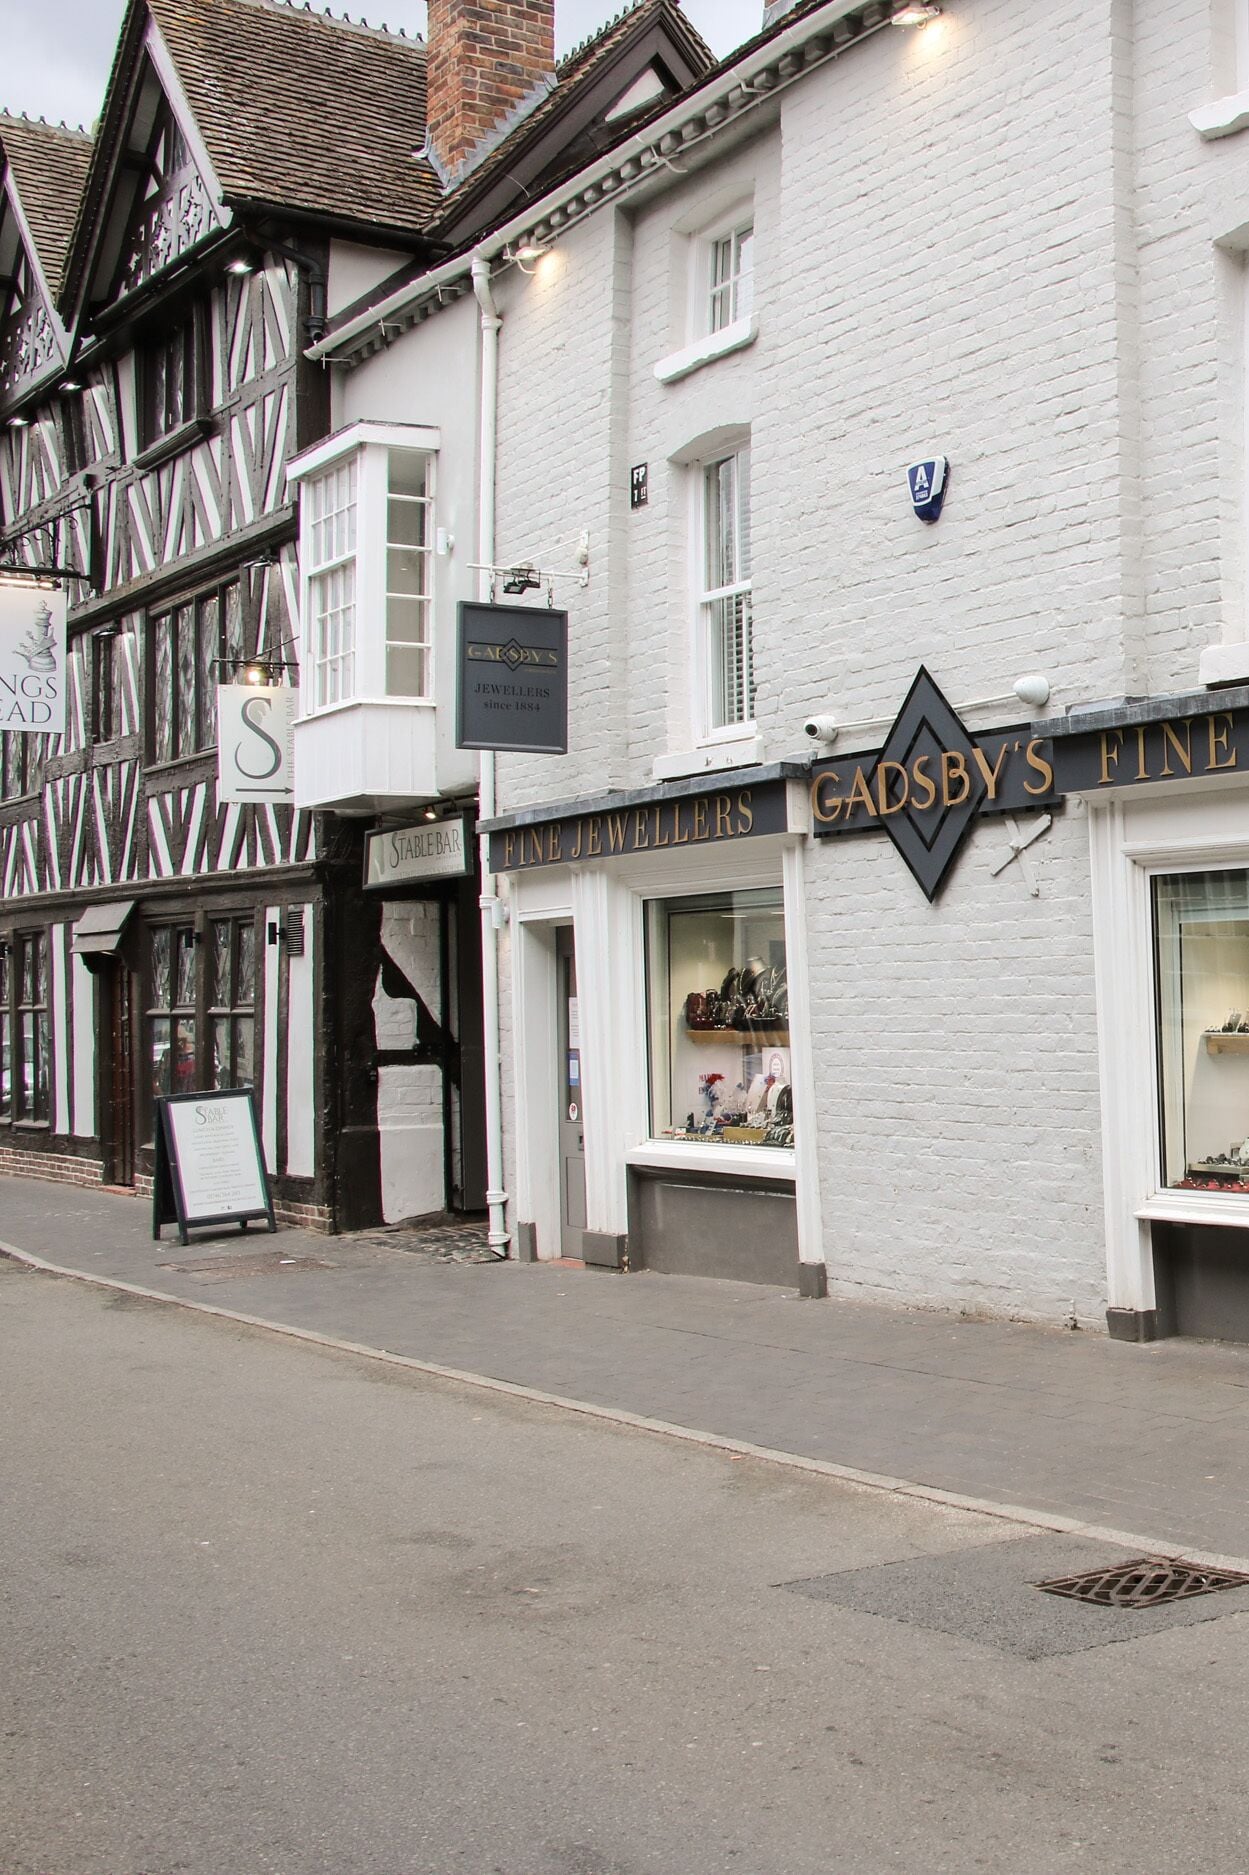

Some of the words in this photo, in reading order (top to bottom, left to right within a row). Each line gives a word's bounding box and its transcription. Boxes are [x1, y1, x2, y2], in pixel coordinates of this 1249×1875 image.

[633, 466, 646, 484] FP
[914, 465, 929, 491] A
[474, 683, 550, 697] JEWELLERS
[0, 701, 52, 723] AD
[483, 700, 512, 711] since
[515, 701, 541, 712] 1884
[1098, 712, 1238, 785] FINE
[811, 739, 1053, 822] GADSBY'S
[503, 824, 562, 868] FINE
[571, 790, 753, 858] JEWELLERS
[390, 831, 434, 868] STABLE
[436, 828, 461, 855] BAR
